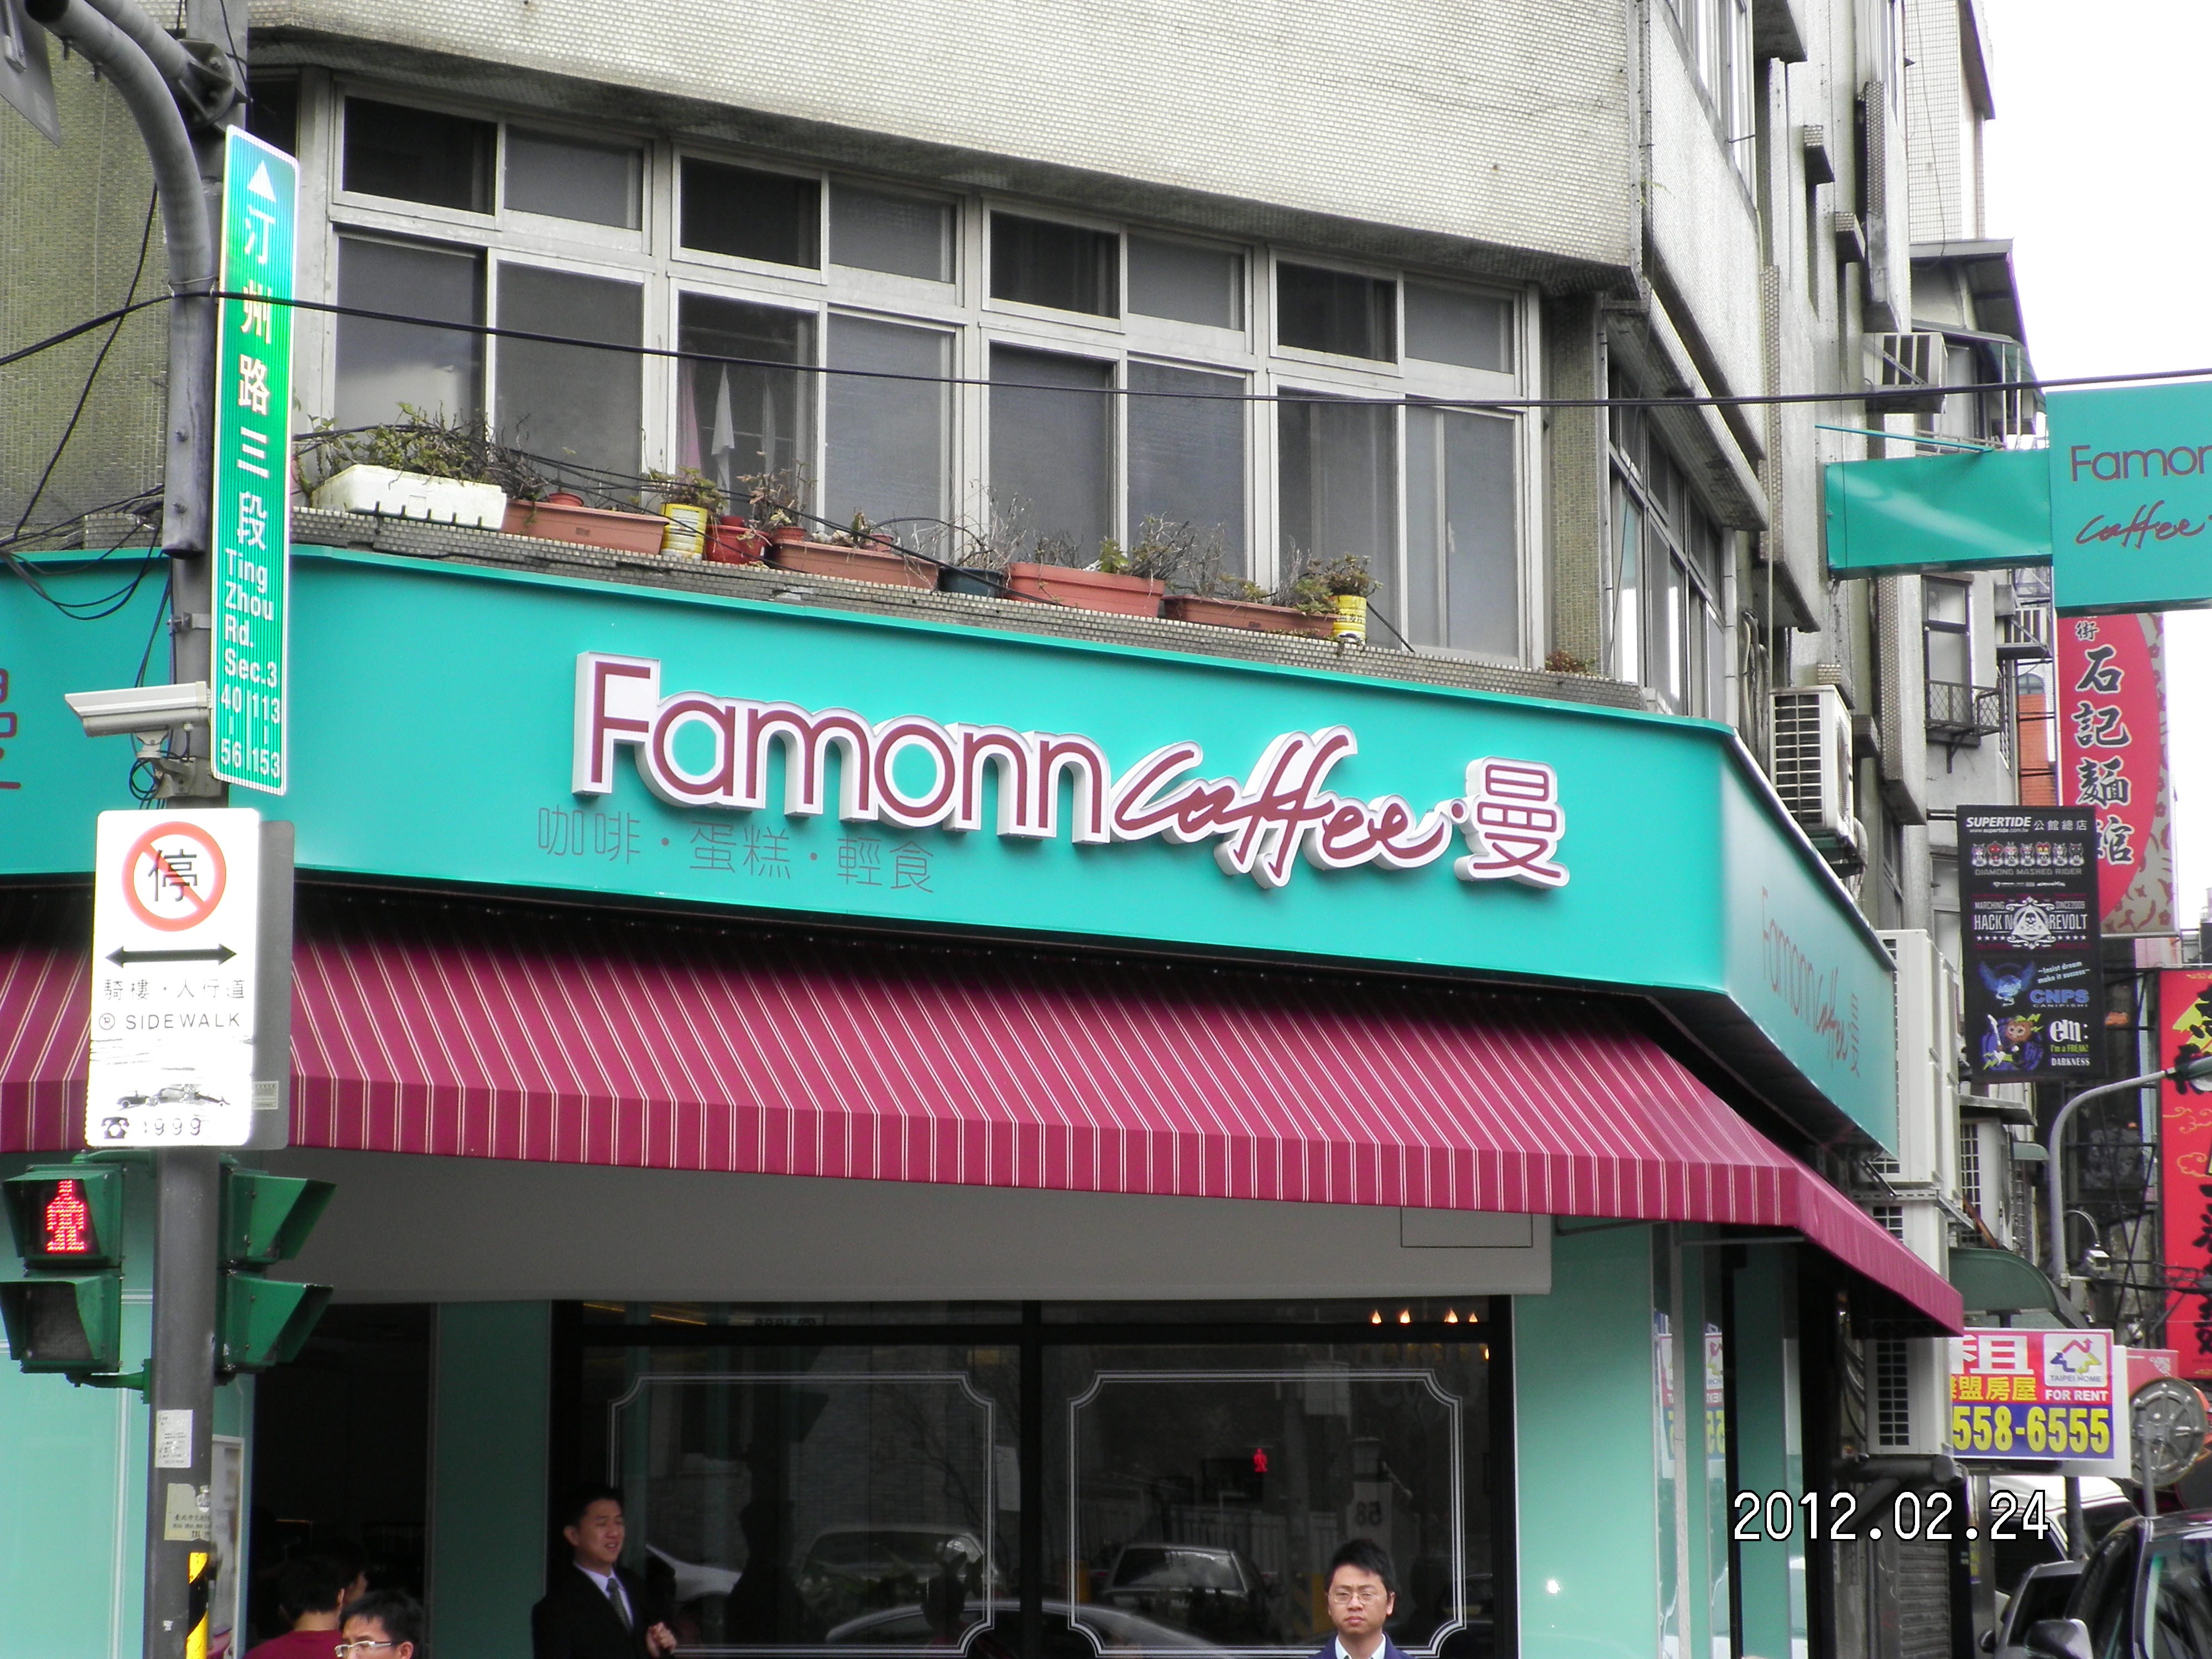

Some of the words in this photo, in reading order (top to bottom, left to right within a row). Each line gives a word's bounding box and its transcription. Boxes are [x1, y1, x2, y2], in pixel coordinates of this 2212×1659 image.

[237, 204, 275, 550] 汀州路三段
[225, 547, 268, 593] Ting
[225, 581, 274, 621] Zhou
[224, 614, 254, 648] Rd.
[221, 684, 242, 713] 40
[252, 692, 280, 724] 113
[221, 738, 242, 768] 56
[252, 747, 280, 778] 153
[578, 653, 1108, 842] Famonn
[1966, 817, 2031, 827] SUPERTIDE
[2034, 820, 2088, 831] 公館總店
[148, 849, 197, 901] 停
[1974, 914, 2002, 930] HACK
[2005, 914, 2013, 930] N
[2049, 914, 2088, 930] REVOLT
[2037, 975, 2055, 984] make
[2030, 989, 2090, 1004] CNPS
[126, 1013, 240, 1030] SIDEWALK
[2051, 1057, 2090, 1066] DARKNESS
[2045, 1390, 2071, 1401] FOR
[2074, 1390, 2109, 1401] RENT
[1953, 1406, 2110, 1453] 558-6555
